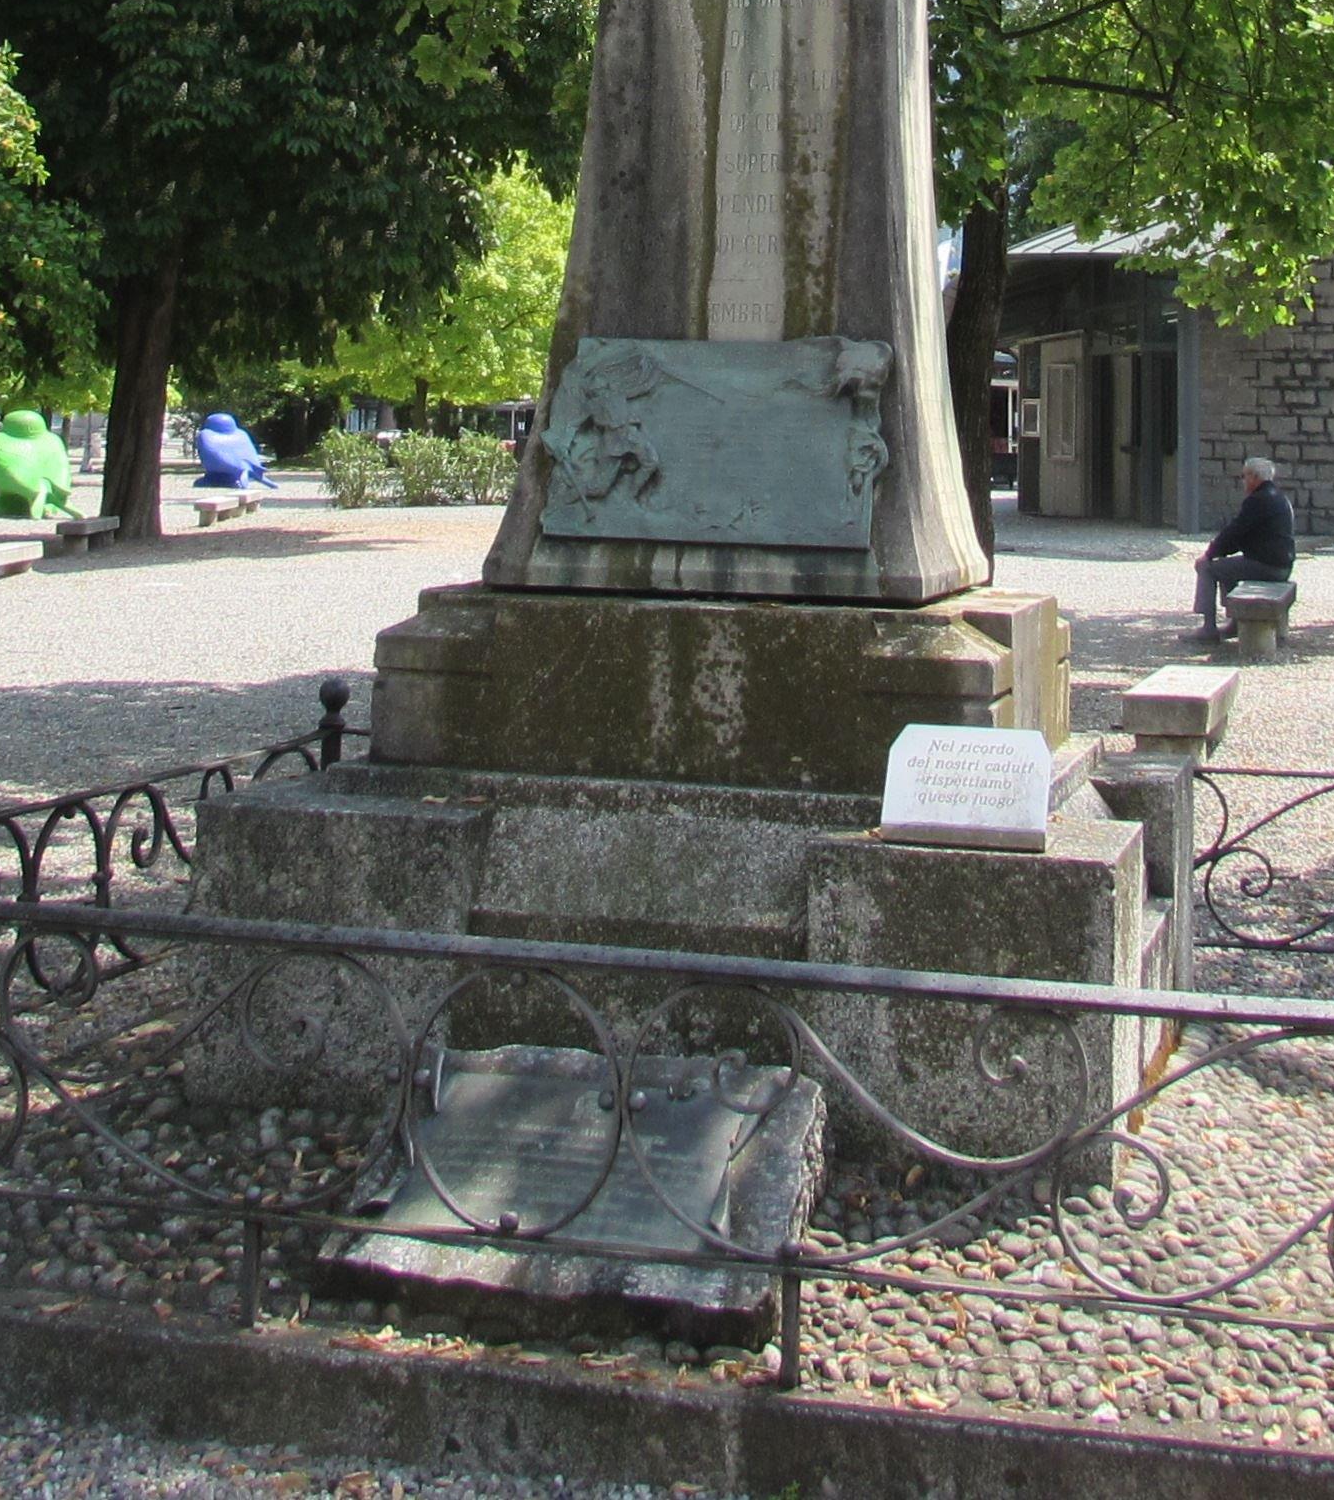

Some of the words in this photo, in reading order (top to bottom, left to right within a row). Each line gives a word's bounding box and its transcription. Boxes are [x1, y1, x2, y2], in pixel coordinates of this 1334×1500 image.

[927, 739, 955, 754] Nel
[958, 742, 1015, 756] ricordo
[906, 755, 930, 770] dei
[934, 758, 980, 772] nostri
[984, 761, 1035, 775] caduti
[923, 773, 1013, 790] rispettiamo
[917, 791, 968, 807] questo
[972, 793, 1015, 809] luogo
